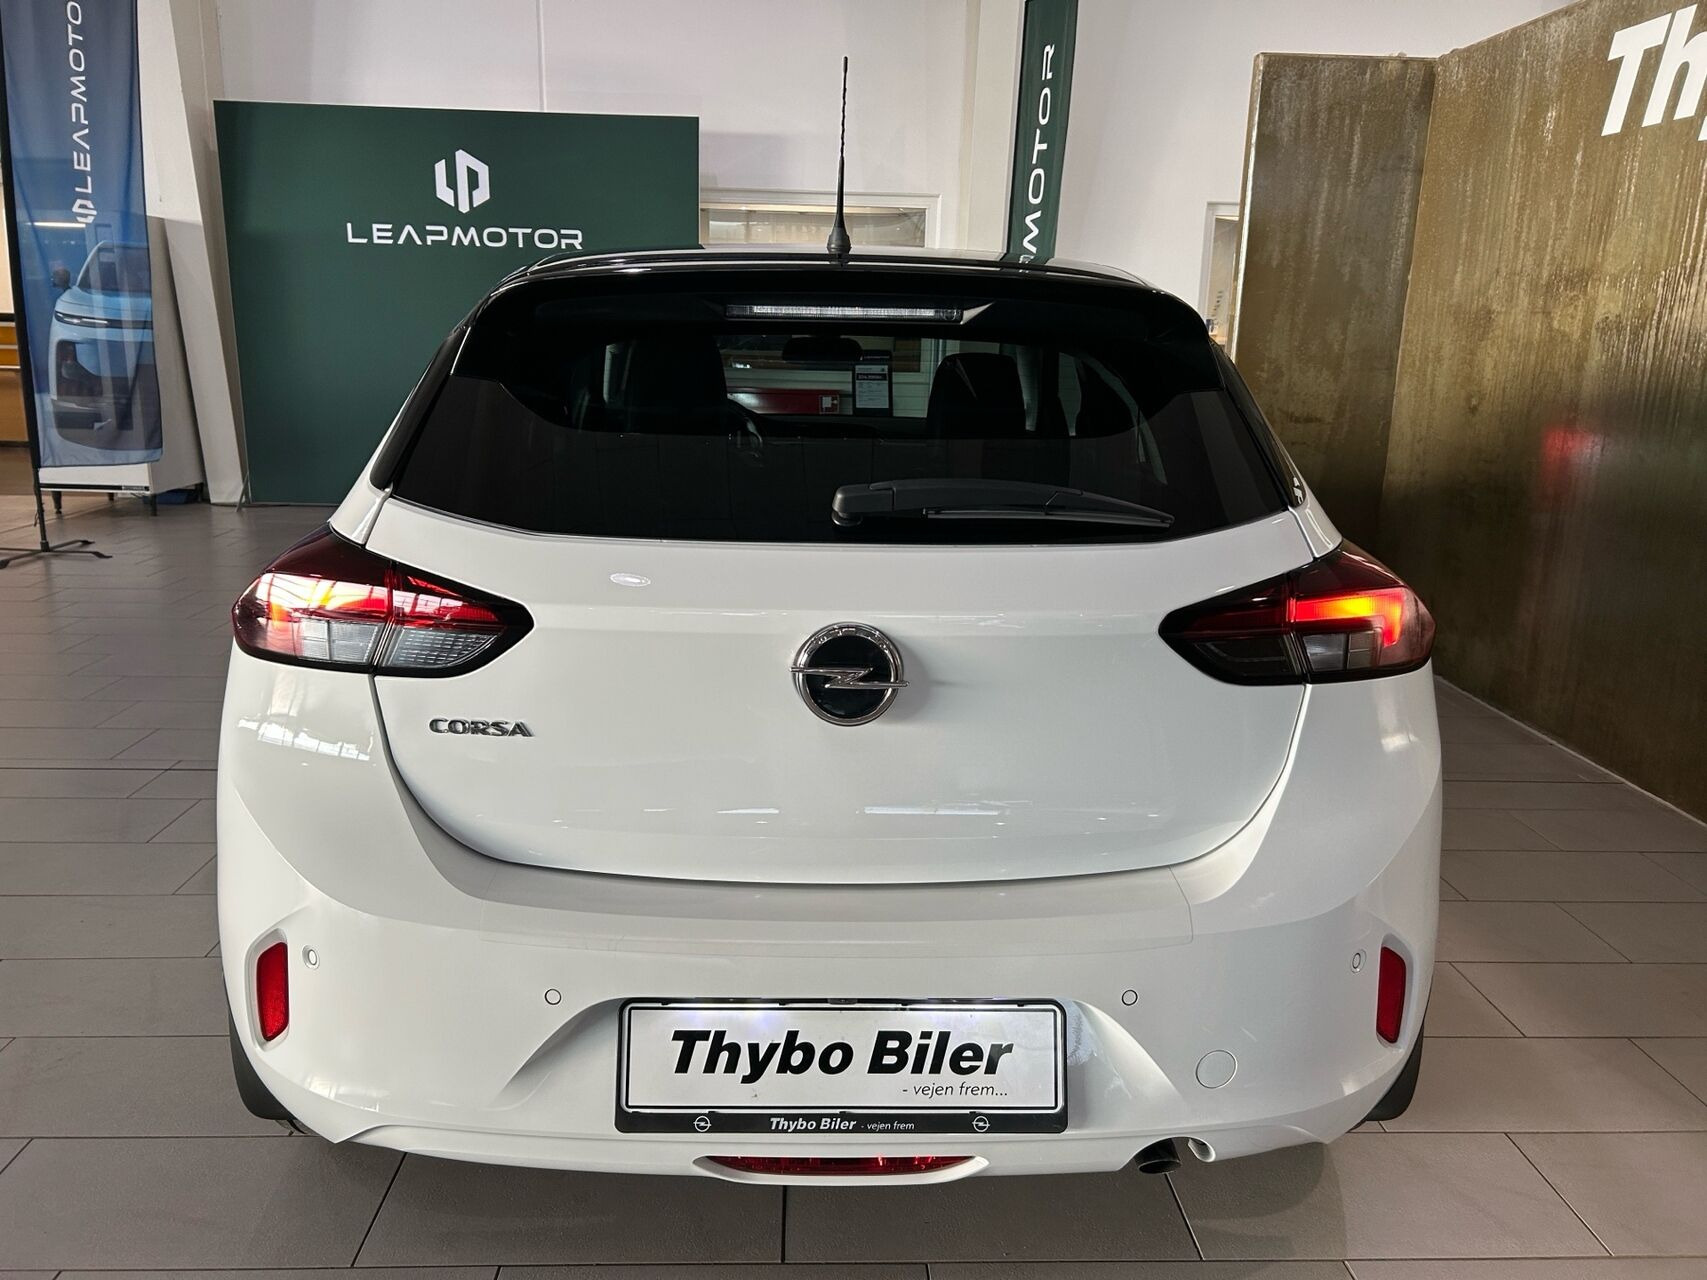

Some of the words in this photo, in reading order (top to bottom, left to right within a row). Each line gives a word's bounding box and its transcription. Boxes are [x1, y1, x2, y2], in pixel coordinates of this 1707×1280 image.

[1601, 3, 1707, 141] Th
[346, 222, 583, 250] LEAPMOTOR
[428, 718, 533, 737] CORSA
[671, 1030, 854, 1084] Thybo
[867, 1030, 1014, 1075] Biler
[913, 1082, 955, 1099] vejen
[959, 1081, 1008, 1096] frem...
[770, 1117, 816, 1132] Thybo
[819, 1117, 857, 1130] Biler
[866, 1121, 891, 1132] vejen
[893, 1120, 915, 1130] frem
